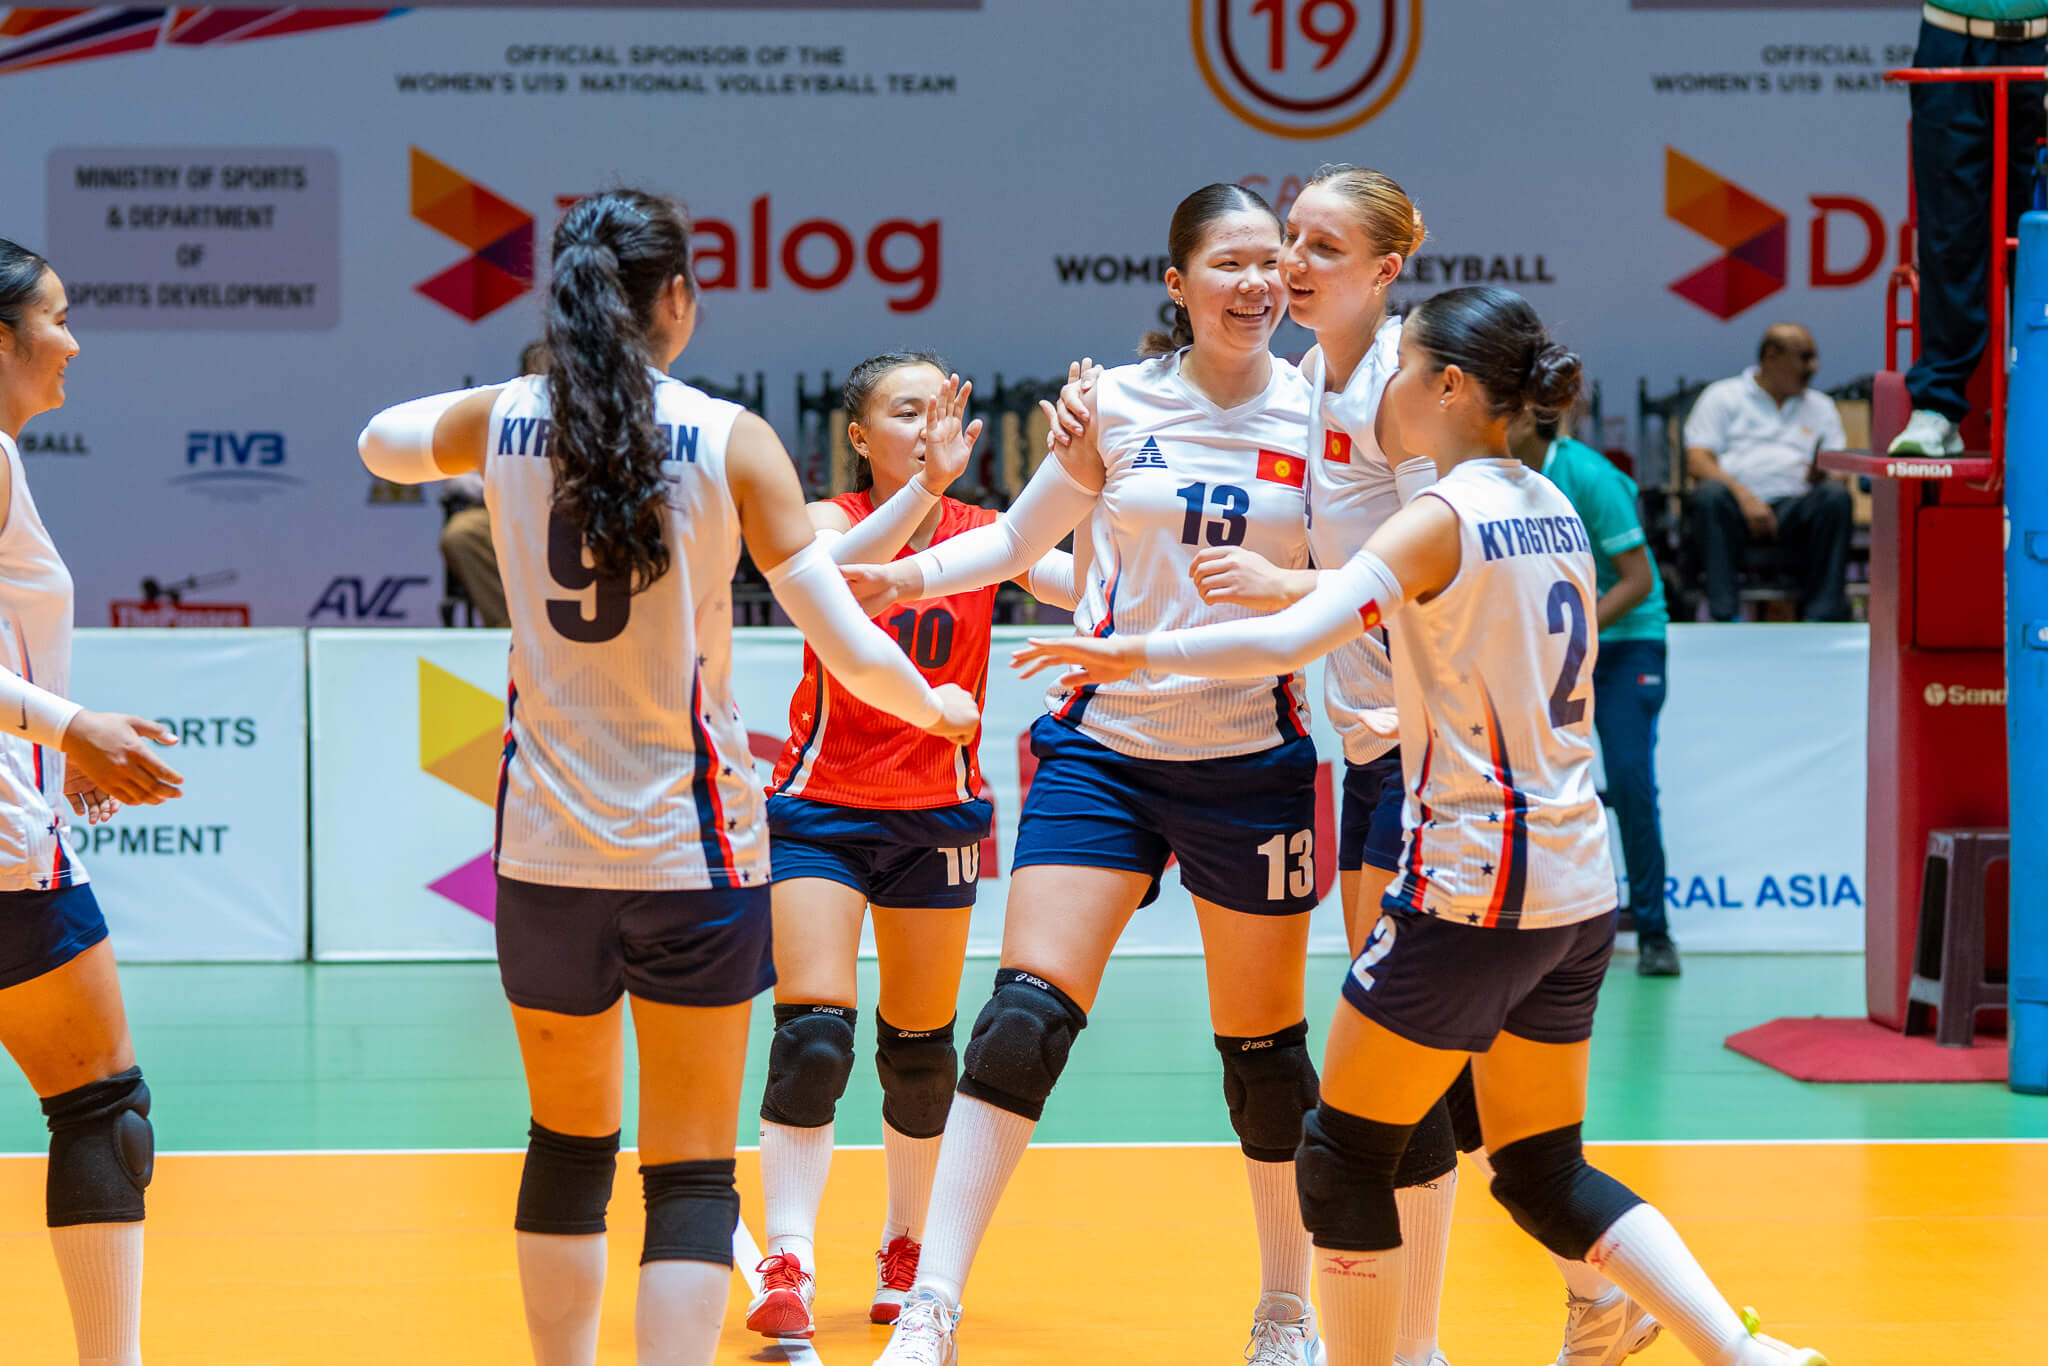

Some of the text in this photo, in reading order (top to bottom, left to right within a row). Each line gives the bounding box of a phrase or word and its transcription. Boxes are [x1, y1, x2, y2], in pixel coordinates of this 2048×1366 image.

[1251, 0, 1358, 72] 19
[506, 46, 845, 66] OFFICIAL SPONSOR OF THE
[1762, 46, 1875, 66] OFFICIAL
[396, 74, 957, 94] WOMEN'S U19 NATIONAL VOLLEYBALL TEAM
[1653, 74, 1770, 93] WOMEN'S
[1779, 74, 1822, 93] U19
[76, 166, 307, 190] MINISTRY OF SPORTS
[107, 206, 275, 229] & DEPARTMENT
[176, 245, 204, 268] OF
[70, 284, 316, 307] SPORTS DEVELOPMENT
[187, 433, 286, 466] FIVB
[1177, 482, 1250, 547] 13
[546, 500, 662, 643] 9
[308, 575, 429, 620] AVC
[890, 607, 954, 669] 10
[1547, 580, 1587, 729] 2
[937, 842, 980, 886] 10
[1257, 828, 1314, 900] 13
[1755, 874, 1863, 908] ASIA
[1352, 914, 1396, 991] 2
